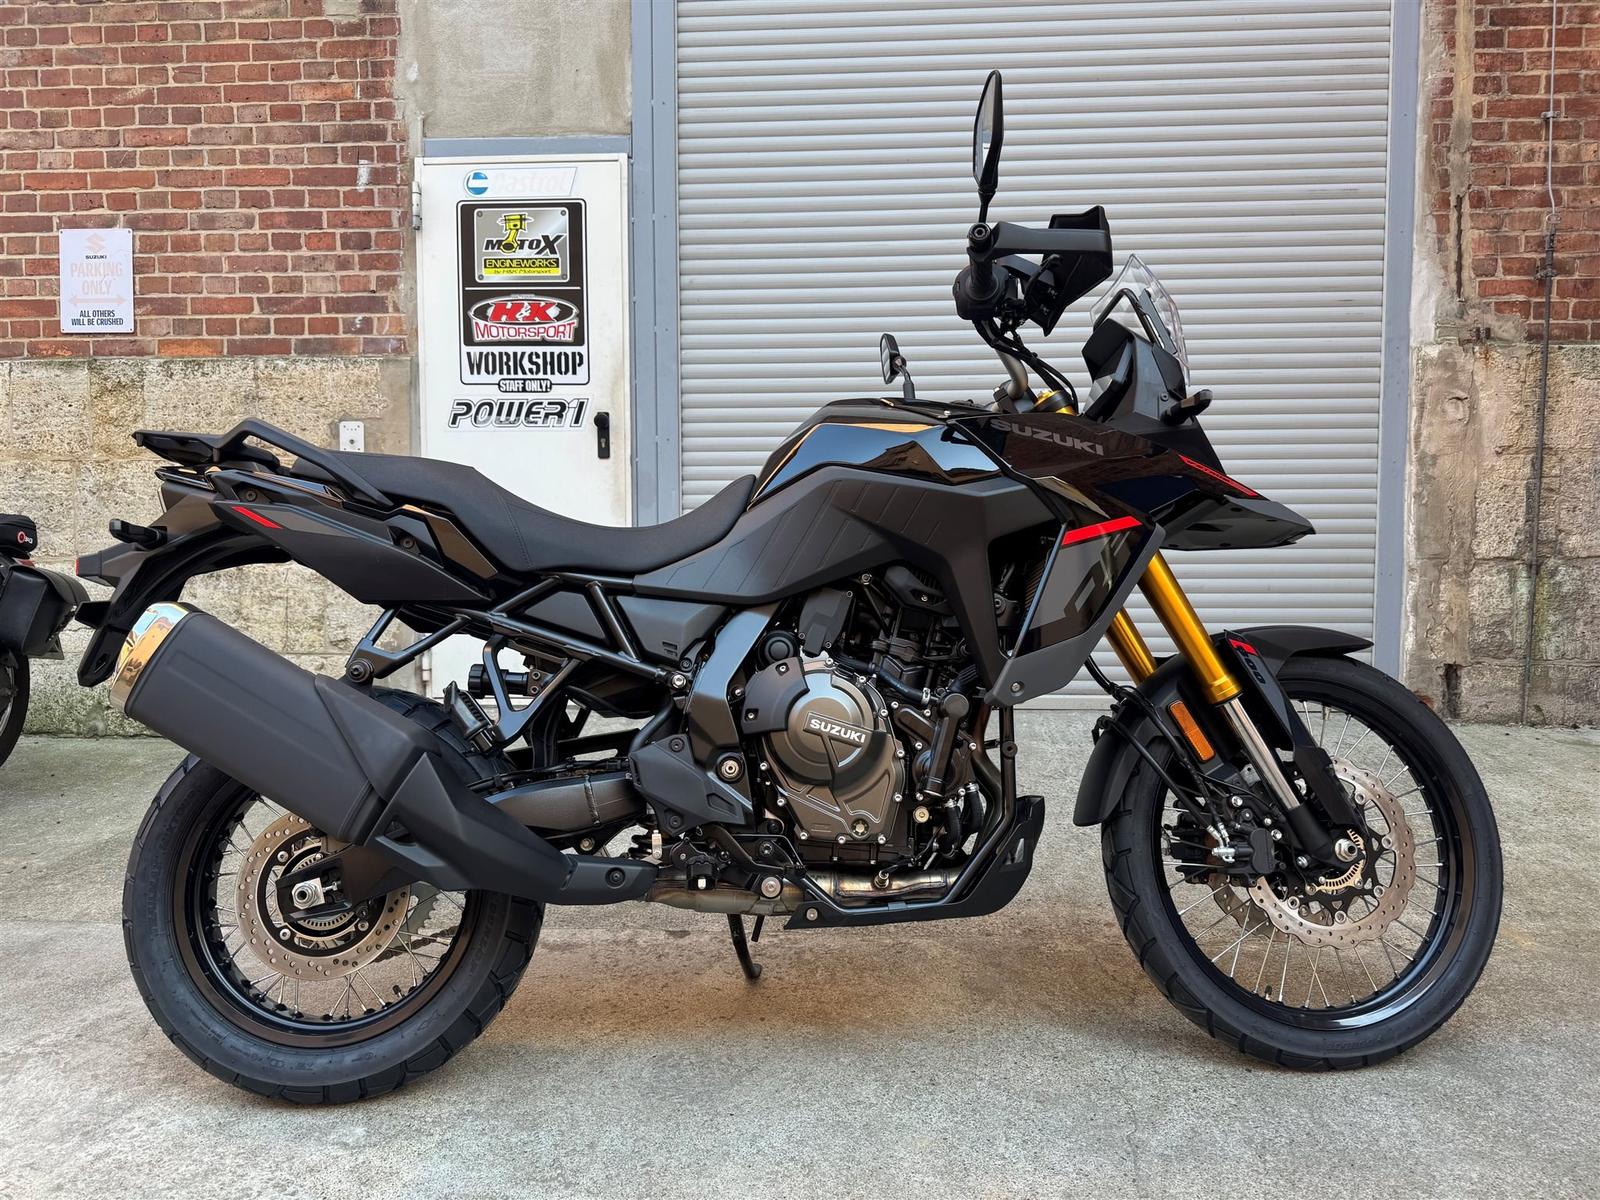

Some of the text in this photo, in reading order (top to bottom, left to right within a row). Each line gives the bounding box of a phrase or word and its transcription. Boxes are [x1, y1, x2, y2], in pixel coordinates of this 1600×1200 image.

[70, 261, 123, 277] PARKING
[486, 259, 557, 268] ENGINEWORKS
[82, 280, 112, 295] ONLY
[489, 302, 557, 321] H&K
[71, 318, 85, 326] WILL
[475, 322, 575, 339] MOTORSPORT
[466, 351, 584, 375] WORKSHOP
[500, 380, 551, 391] STAFF ONLY!
[449, 399, 588, 427] POWER1
[990, 418, 1104, 456] SUZUKI
[810, 719, 866, 743] SUZUKI
